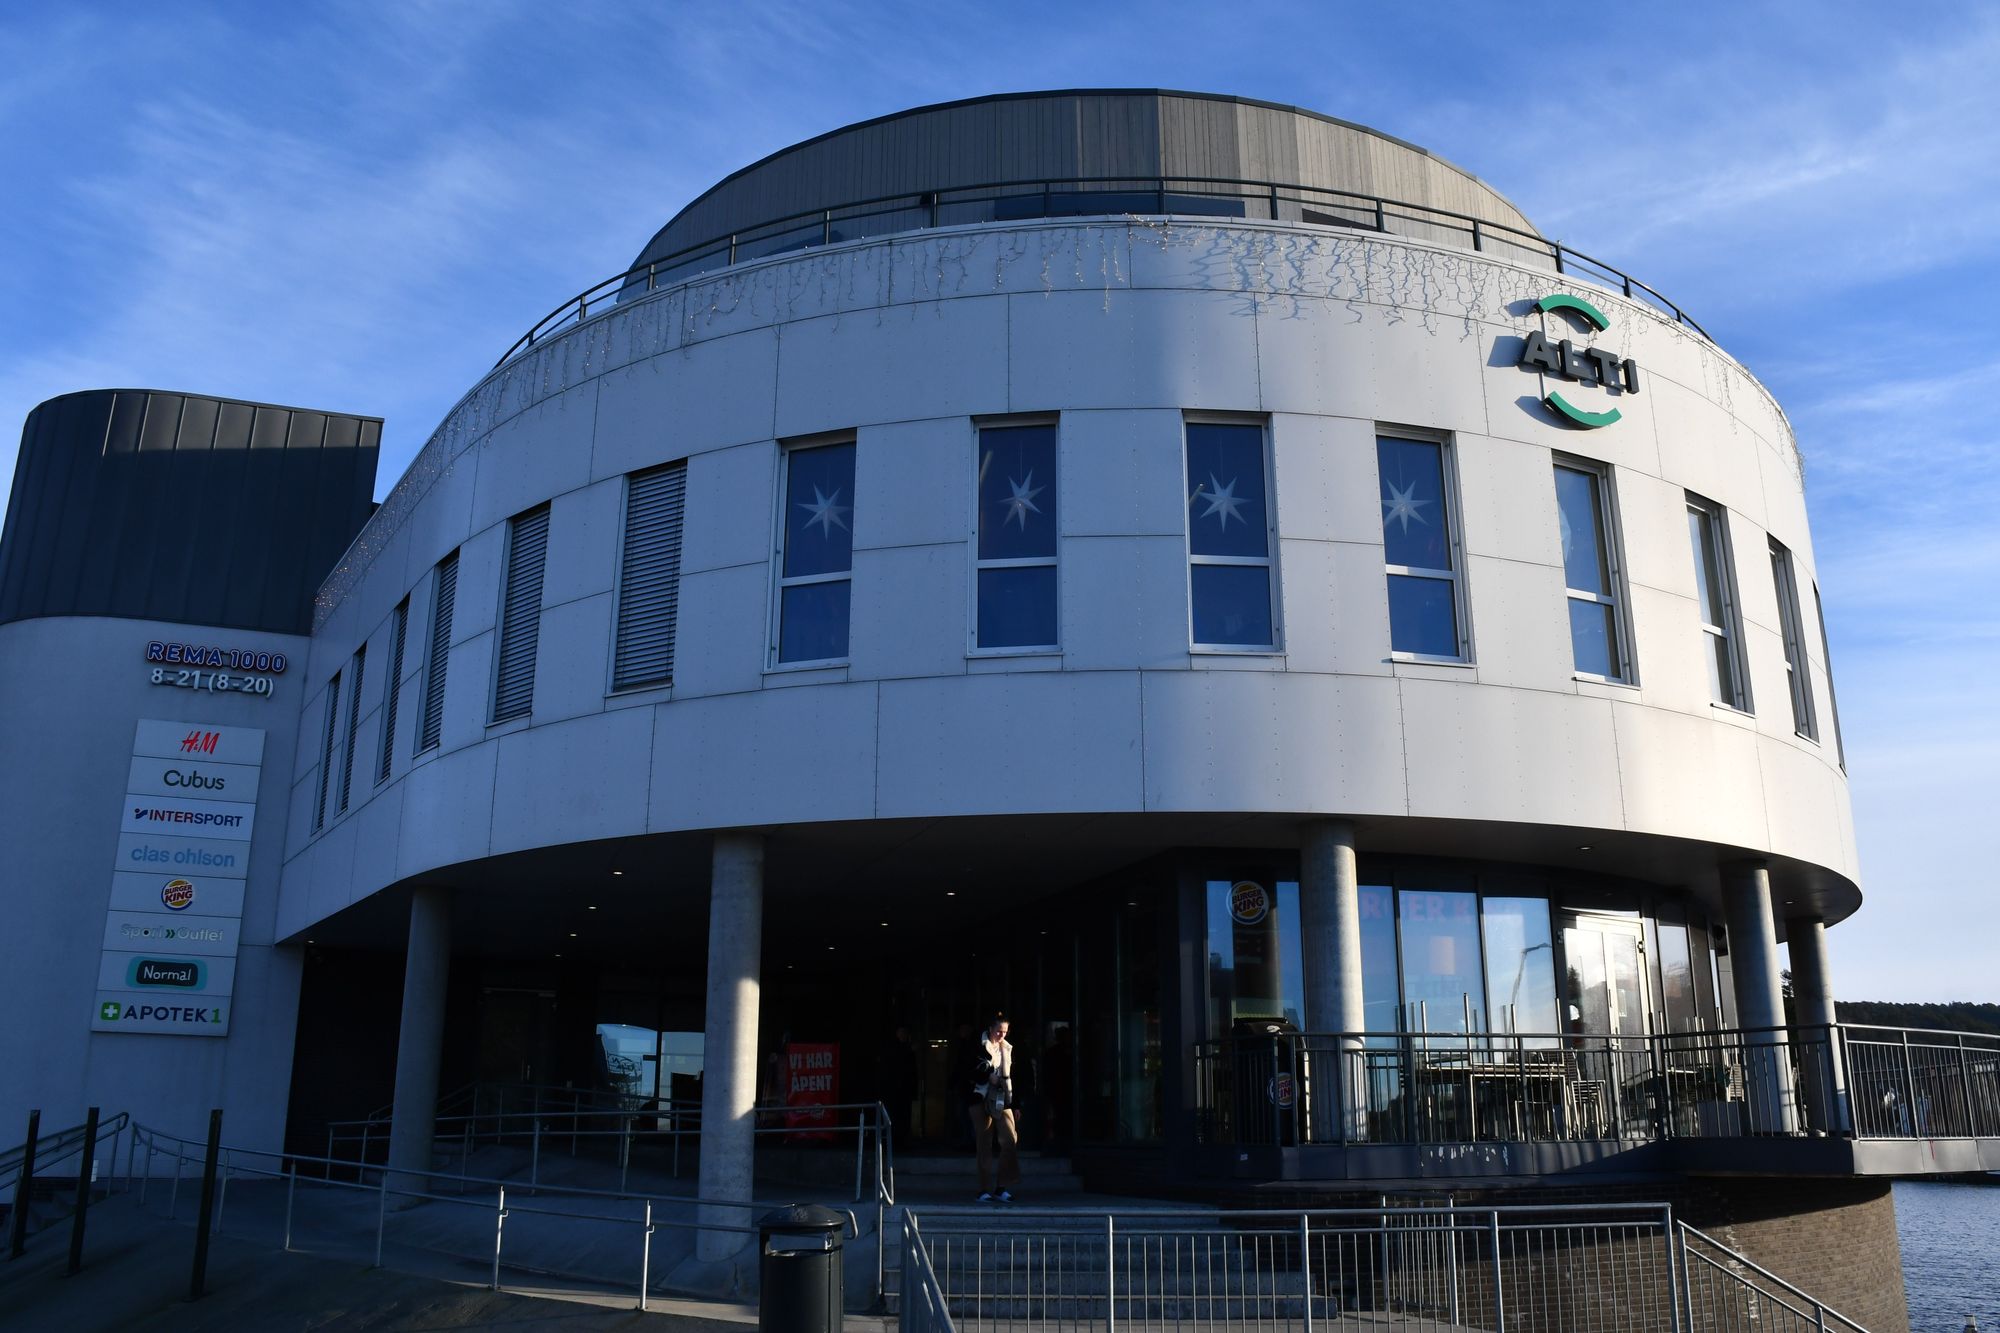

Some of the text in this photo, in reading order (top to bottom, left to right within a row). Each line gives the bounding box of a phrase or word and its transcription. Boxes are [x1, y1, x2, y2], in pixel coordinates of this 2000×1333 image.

[1521, 330, 1640, 395] ALTI
[147, 641, 287, 673] REMA 1000
[180, 730, 221, 755] H&M
[163, 769, 225, 790] Cubus
[149, 808, 244, 828] INTERSPORT
[130, 844, 236, 868] clas ohlson
[164, 883, 193, 896] BURGER
[165, 890, 193, 904] KING
[1232, 888, 1263, 904] BURGER
[1234, 897, 1264, 913] KING
[177, 927, 224, 942] Outlet
[143, 965, 192, 982] Normal
[123, 1004, 222, 1024] APOTEK 1
[790, 1052, 832, 1068] VI HAR
[792, 1072, 832, 1091] ÅPENT
